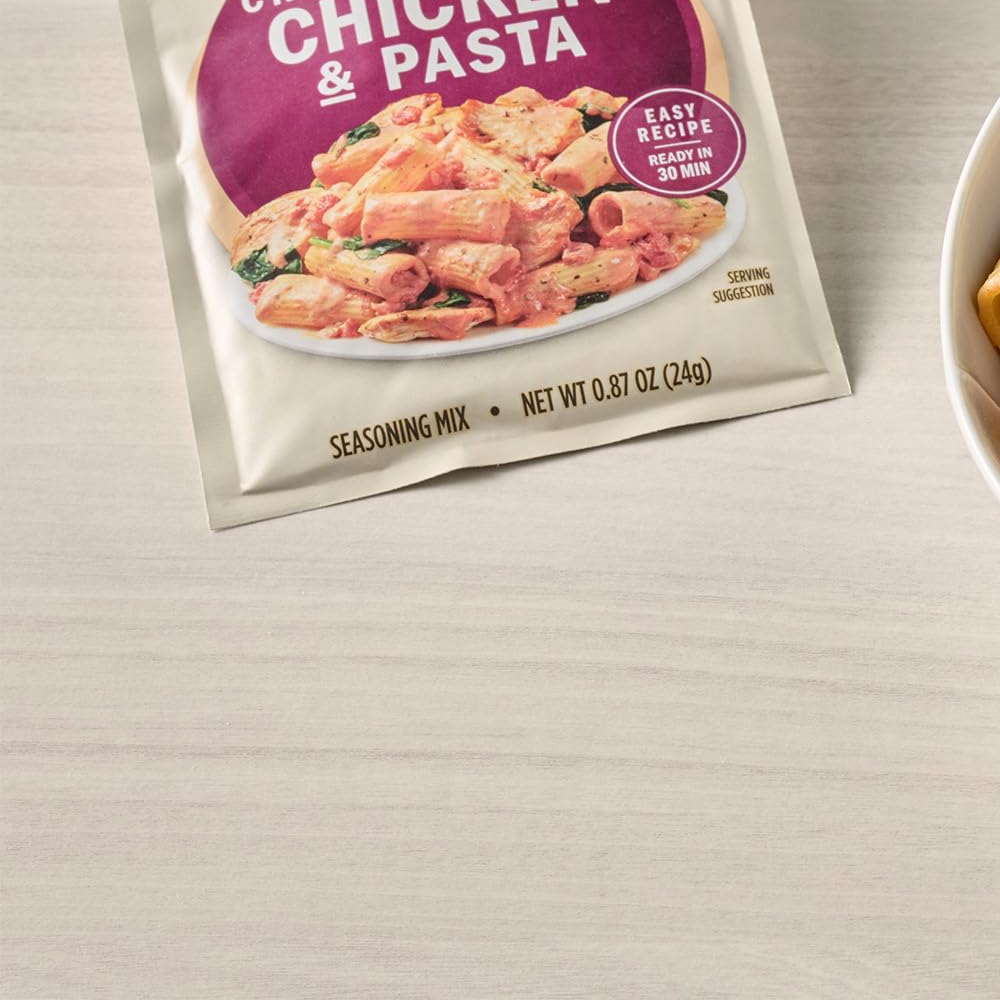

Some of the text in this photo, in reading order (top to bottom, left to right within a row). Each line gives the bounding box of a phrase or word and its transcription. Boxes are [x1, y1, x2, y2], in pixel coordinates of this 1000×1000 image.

[317, 15, 587, 100] & PASTA
[644, 103, 695, 124] EASY
[637, 119, 713, 143] RECIPE
[648, 147, 713, 166] READY IN
[657, 161, 712, 181] 30 MIN
[727, 267, 771, 284] SERVING
[712, 283, 775, 303] SUGGESTION
[330, 356, 712, 459] SEASONING MIX NET WT 0.87 OZ (24g)
